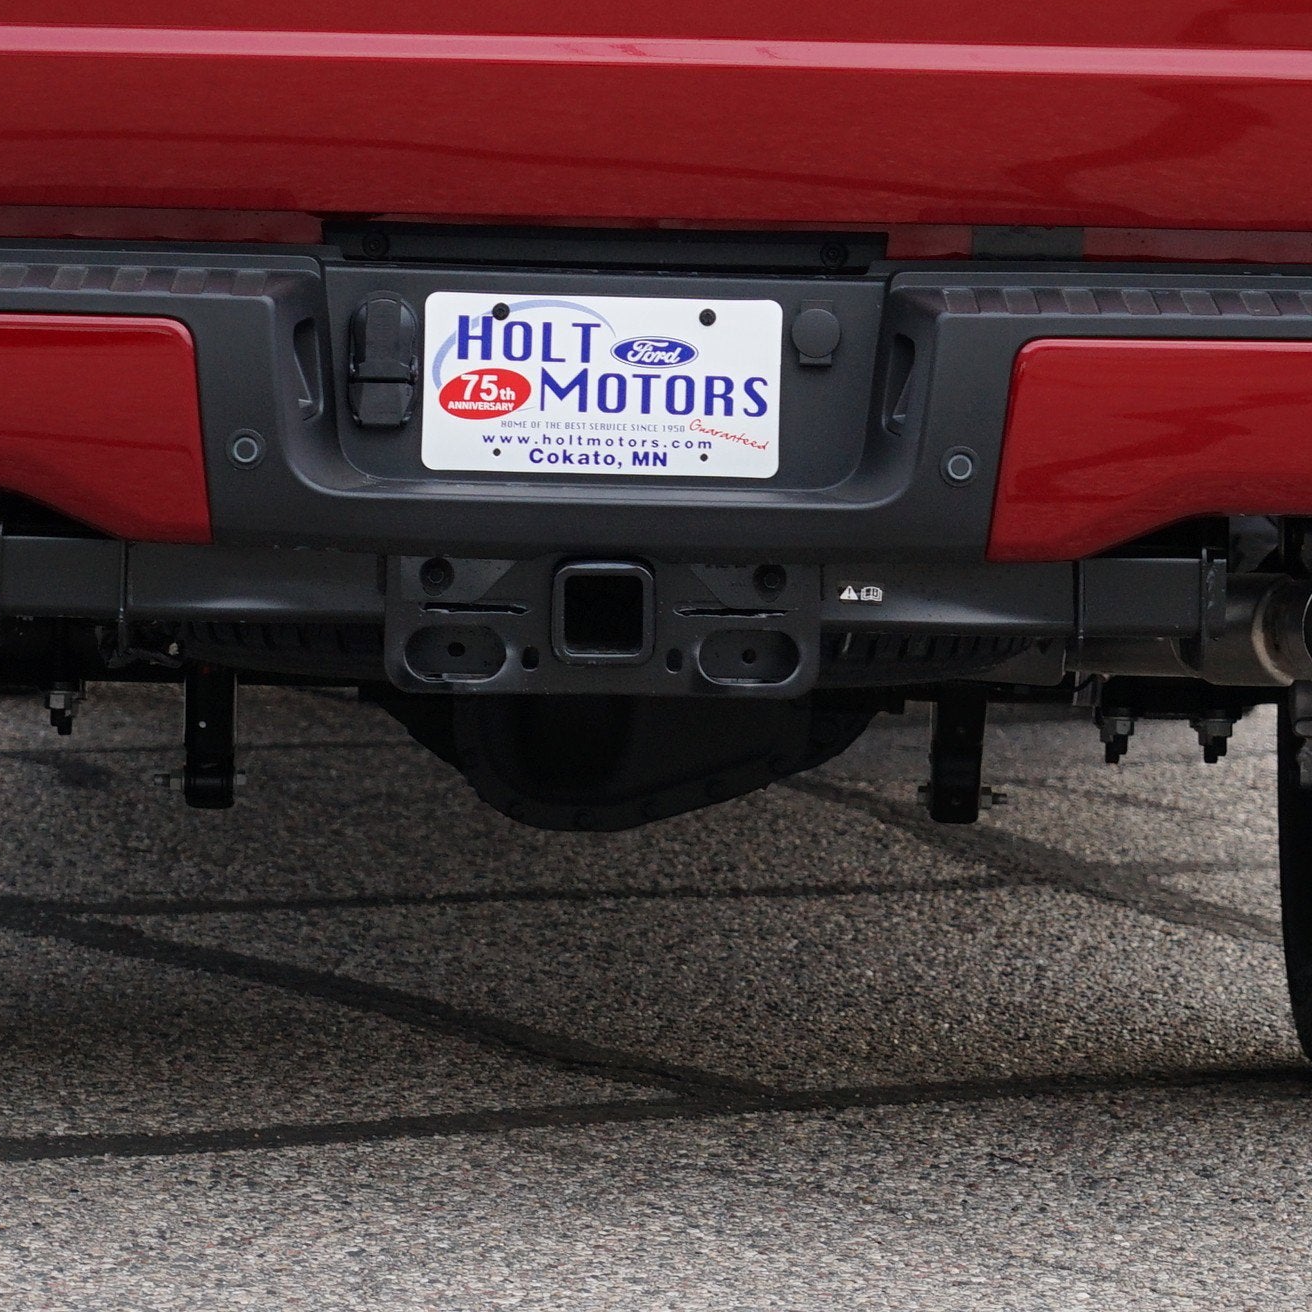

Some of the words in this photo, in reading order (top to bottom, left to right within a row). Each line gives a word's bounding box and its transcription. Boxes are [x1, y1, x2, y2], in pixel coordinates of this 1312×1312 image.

[457, 315, 602, 364] HOLT
[626, 340, 683, 364] Ford
[460, 374, 516, 401] 75th
[540, 366, 769, 417] MOTORS
[448, 400, 516, 412] ANNIVERSARY
[500, 420, 527, 429] HOME
[531, 420, 542, 429] OF
[545, 421, 562, 430] THE
[565, 421, 586, 430] BEST
[589, 422, 627, 431] SERVICE
[630, 423, 659, 432] SINCE
[662, 424, 686, 433] 1950
[689, 418, 770, 450] Guaranteed
[482, 434, 712, 450] www.holtmotors.com
[529, 448, 623, 469] Cokato,
[631, 451, 668, 467] MN
